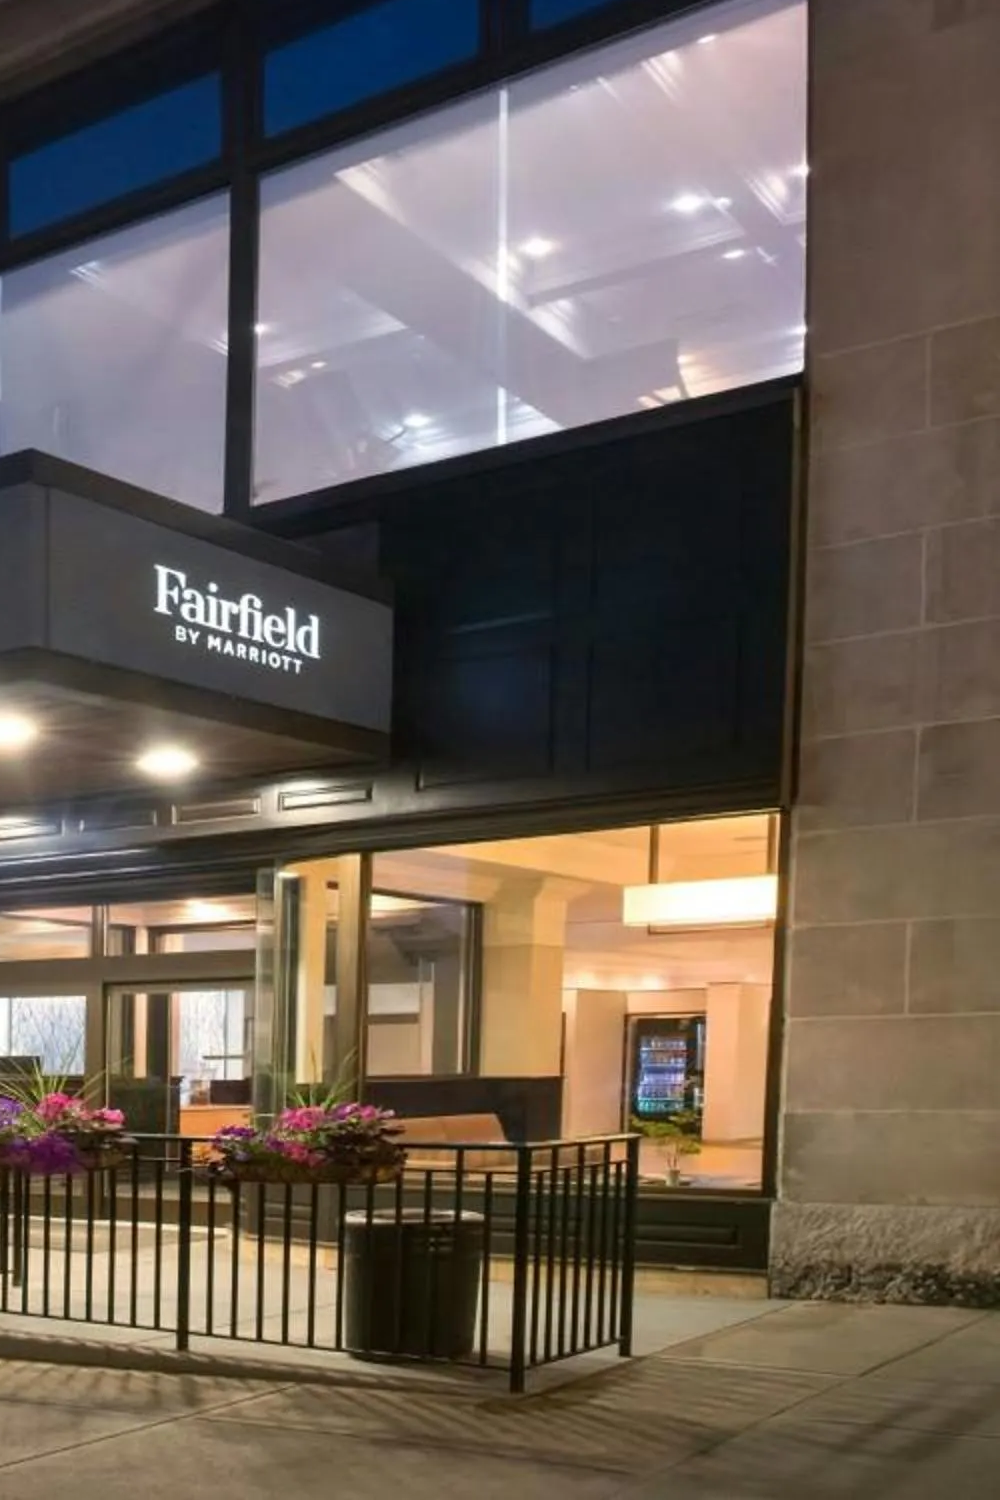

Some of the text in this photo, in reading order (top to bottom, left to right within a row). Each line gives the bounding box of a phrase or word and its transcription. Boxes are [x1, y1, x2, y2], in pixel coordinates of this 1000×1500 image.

[153, 563, 321, 660] Fairfield
[174, 625, 303, 675] BY MARRIOTT
